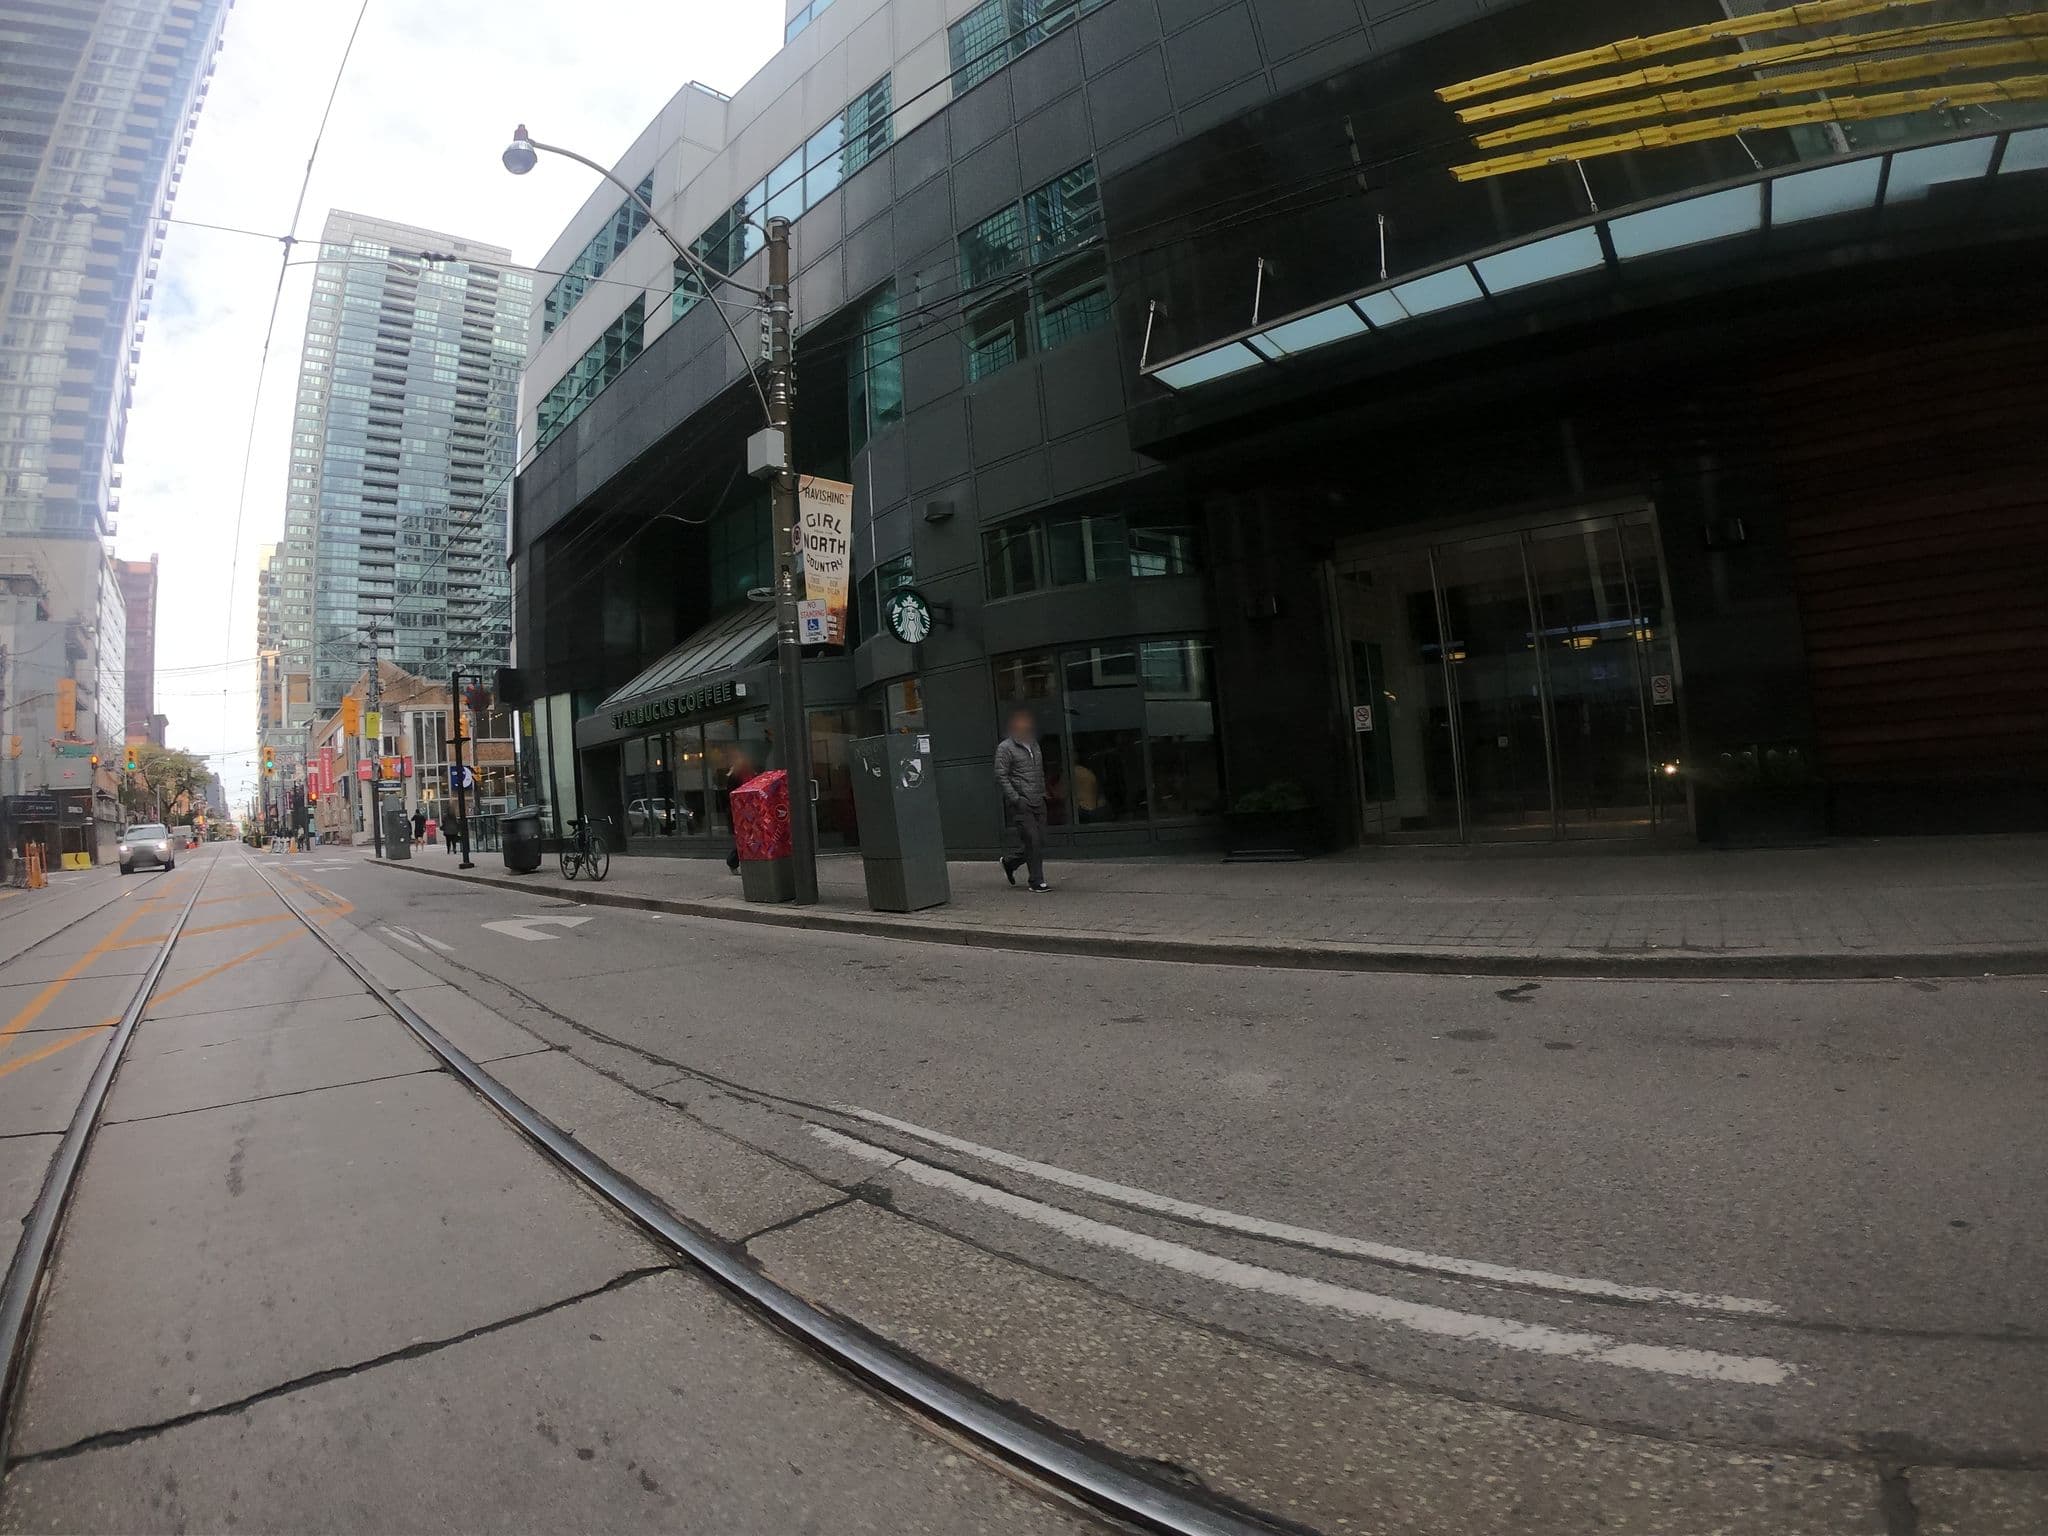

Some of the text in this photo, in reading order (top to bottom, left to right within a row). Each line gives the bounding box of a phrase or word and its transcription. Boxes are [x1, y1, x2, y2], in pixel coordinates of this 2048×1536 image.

[806, 513, 842, 534] GIRL
[804, 533, 846, 555] NORTH
[806, 554, 843, 572] COUNTRY
[808, 601, 817, 609] NO
[611, 699, 676, 729] STARBUCKS
[678, 682, 733, 714] COFFEE
